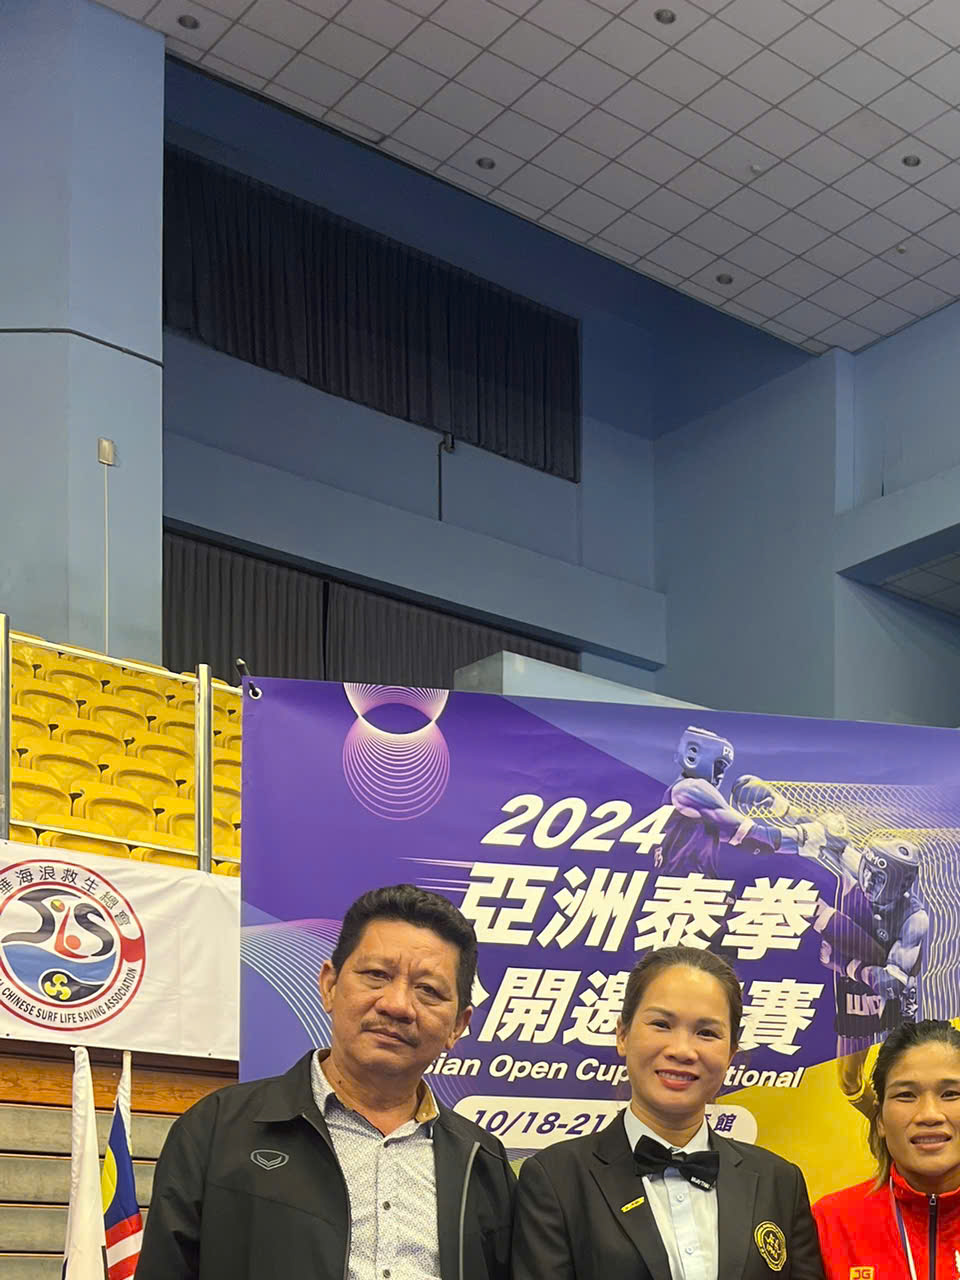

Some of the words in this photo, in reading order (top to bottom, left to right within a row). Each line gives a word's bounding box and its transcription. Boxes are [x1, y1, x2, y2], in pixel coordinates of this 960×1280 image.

[480, 793, 677, 854] 2024
[460, 861, 820, 961] 亞洲泰拳
[2, 987, 36, 1016] CHINESE
[36, 1008, 58, 1023] SURF
[60, 1013, 77, 1024] LIFE
[78, 1005, 107, 1023] SAVING
[105, 966, 138, 1011] ASSOCIATION
[488, 1054, 568, 1083] Open
[581, 1057, 630, 1086] Cup
